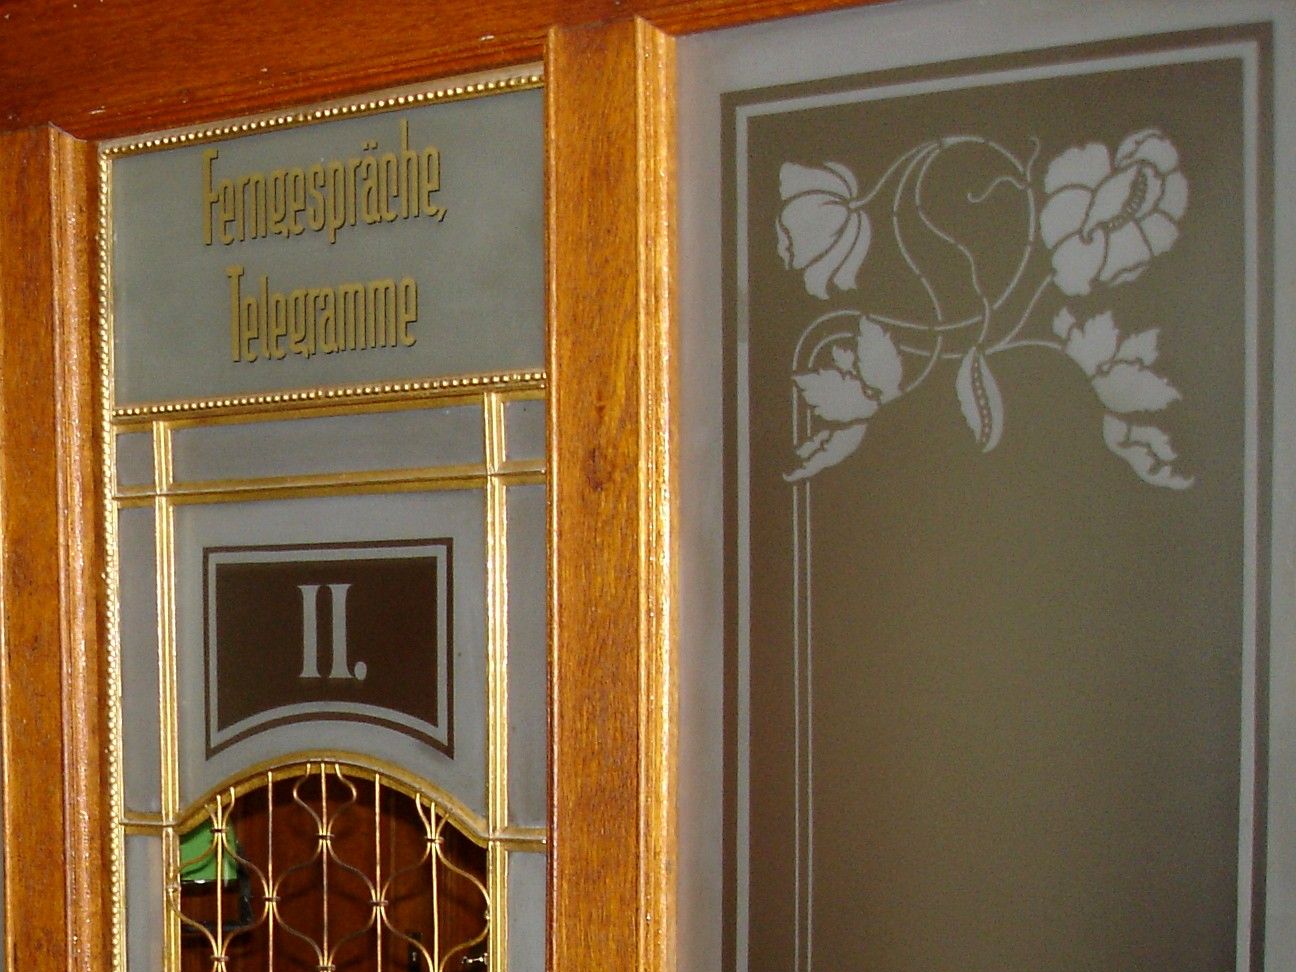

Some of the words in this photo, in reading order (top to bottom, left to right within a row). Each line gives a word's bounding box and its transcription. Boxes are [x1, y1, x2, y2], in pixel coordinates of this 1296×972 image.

[204, 119, 447, 245] Ferngespräche,
[228, 265, 417, 363] Telegramme
[297, 583, 367, 681] II.
